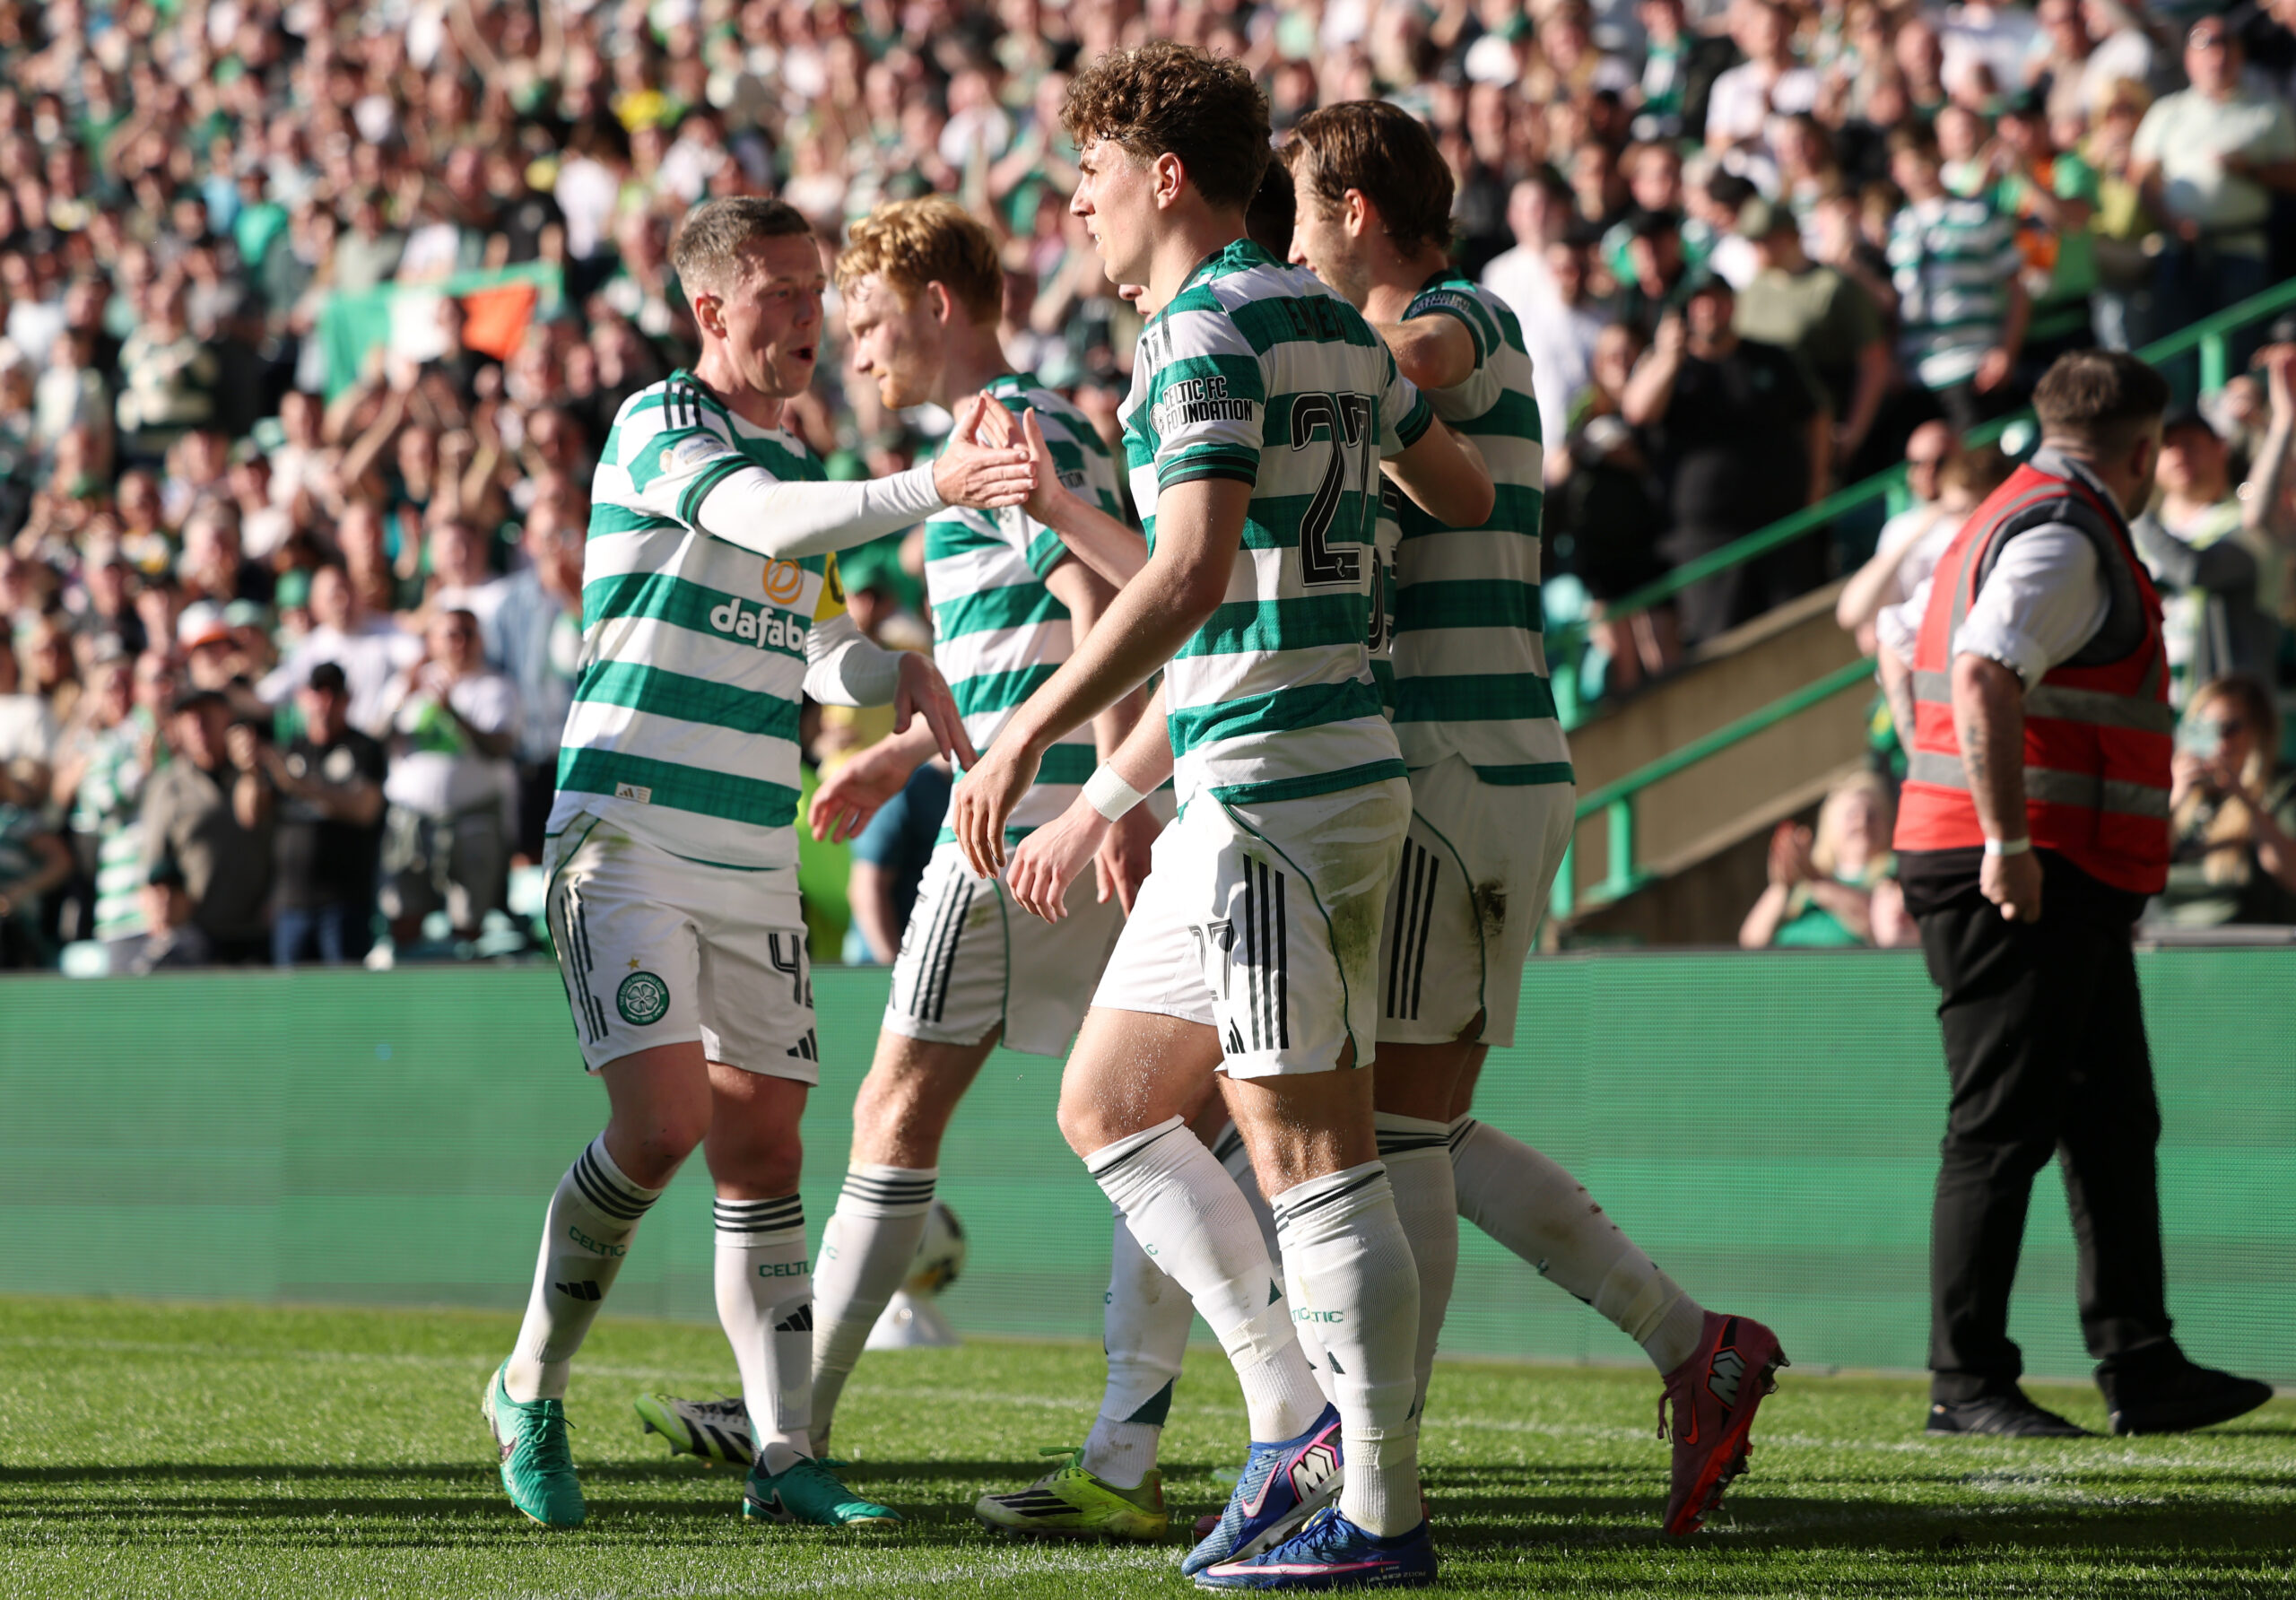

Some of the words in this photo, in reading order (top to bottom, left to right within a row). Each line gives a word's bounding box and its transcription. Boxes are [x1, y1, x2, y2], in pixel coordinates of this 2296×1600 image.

[1163, 378, 1204, 412] CELTIC
[1205, 376, 1227, 400] FC
[1166, 399, 1254, 434] FOUNDATION
[1290, 391, 1373, 588] 27
[769, 933, 814, 1011] 4
[569, 1225, 626, 1257] CELTIC
